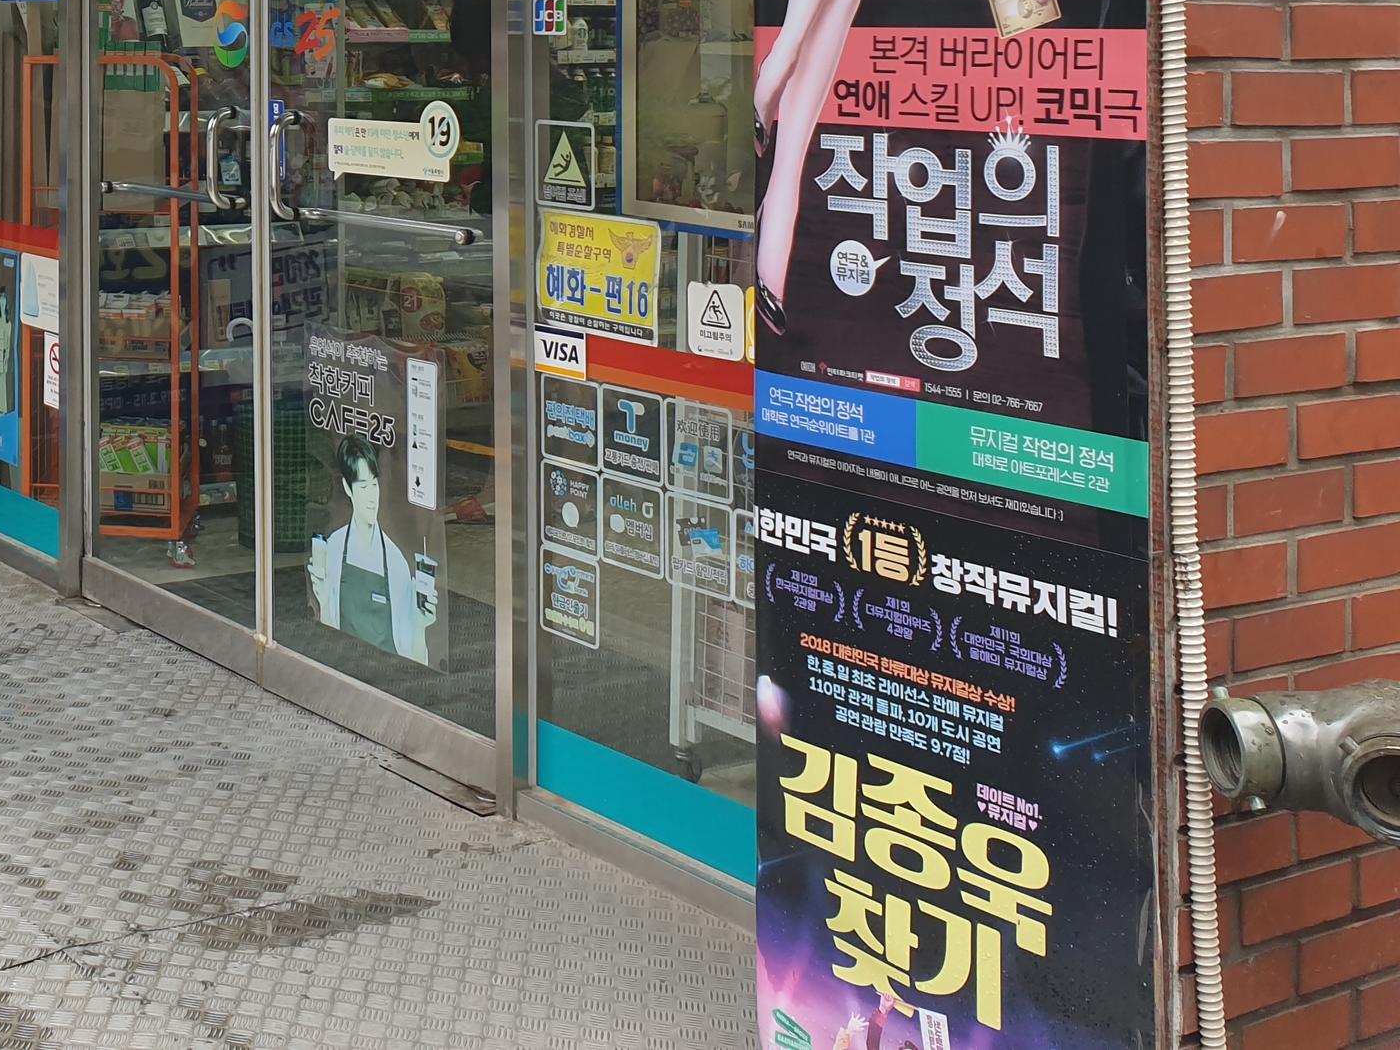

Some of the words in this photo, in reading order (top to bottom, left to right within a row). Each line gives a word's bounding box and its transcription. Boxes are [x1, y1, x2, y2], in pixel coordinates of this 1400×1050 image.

[269, 6, 341, 62] GS25
[534, 8, 565, 24] JCB
[868, 34, 929, 74] 본격
[939, 36, 1105, 80] 버라이어티
[832, 78, 891, 120] 연애
[898, 82, 960, 123] 스킬
[970, 85, 1025, 125] UP!
[1033, 87, 1143, 133] 코믹극
[427, 115, 451, 147] 19
[814, 130, 1061, 260] 작업의
[549, 220, 594, 241] 혜화경찰서
[557, 241, 612, 262] 특별순찰구역
[835, 265, 871, 286] 뮤지컬
[894, 240, 1061, 372] 정석
[541, 338, 579, 364] VISA
[308, 362, 375, 407] 착한커피
[546, 400, 576, 425] 편의점
[576, 408, 596, 430] 택배
[761, 407, 789, 426] 대학로
[769, 386, 794, 407] 연극
[795, 392, 835, 418] 작업의
[836, 401, 864, 424] 정석
[676, 419, 720, 442] 欢迎使用
[969, 425, 1019, 455] 뮤지컬
[1022, 435, 1075, 464] 작업의
[1078, 444, 1115, 473] 정석
[569, 479, 590, 491] HAPPY
[972, 452, 1008, 472] 대학로
[1010, 459, 1087, 488] 아트포레스트
[1088, 474, 1110, 494] 2관
[569, 488, 588, 500] POINT
[626, 518, 654, 542] 멤버십
[775, 577, 834, 605] 한국뮤지컬대상
[857, 529, 910, 584] 1등
[931, 554, 1118, 638] 창작뮤지컬!
[964, 632, 1006, 654] 대한민국
[1009, 645, 1053, 668] 국회대상
[969, 647, 1001, 665] 올해의
[1003, 658, 1048, 681] 뮤지컬상
[800, 632, 832, 655] 2018
[832, 642, 879, 669] 대한민국
[880, 656, 929, 684] 한류대상
[931, 671, 982, 705] 뮤지컬상
[984, 689, 1016, 713] 수상!
[809, 676, 846, 701] 110만
[848, 688, 874, 710] 관객
[876, 697, 906, 722] 돌파,
[907, 709, 939, 733] 10개
[941, 718, 969, 742] 도시
[973, 731, 1001, 754] 공연
[851, 668, 876, 690] 최초
[878, 675, 930, 708] 라이선스
[932, 694, 960, 718] 판매
[963, 705, 1004, 732] 뮤지컬
[835, 705, 860, 728] 공연
[861, 715, 887, 737] 관람
[889, 725, 928, 752] 만족도
[931, 738, 971, 766] 9.7점!
[977, 783, 1015, 812] 데이트
[986, 802, 1027, 831] 뮤지컬
[779, 733, 1053, 957] 김종욱
[824, 868, 1002, 1031] 찾기
